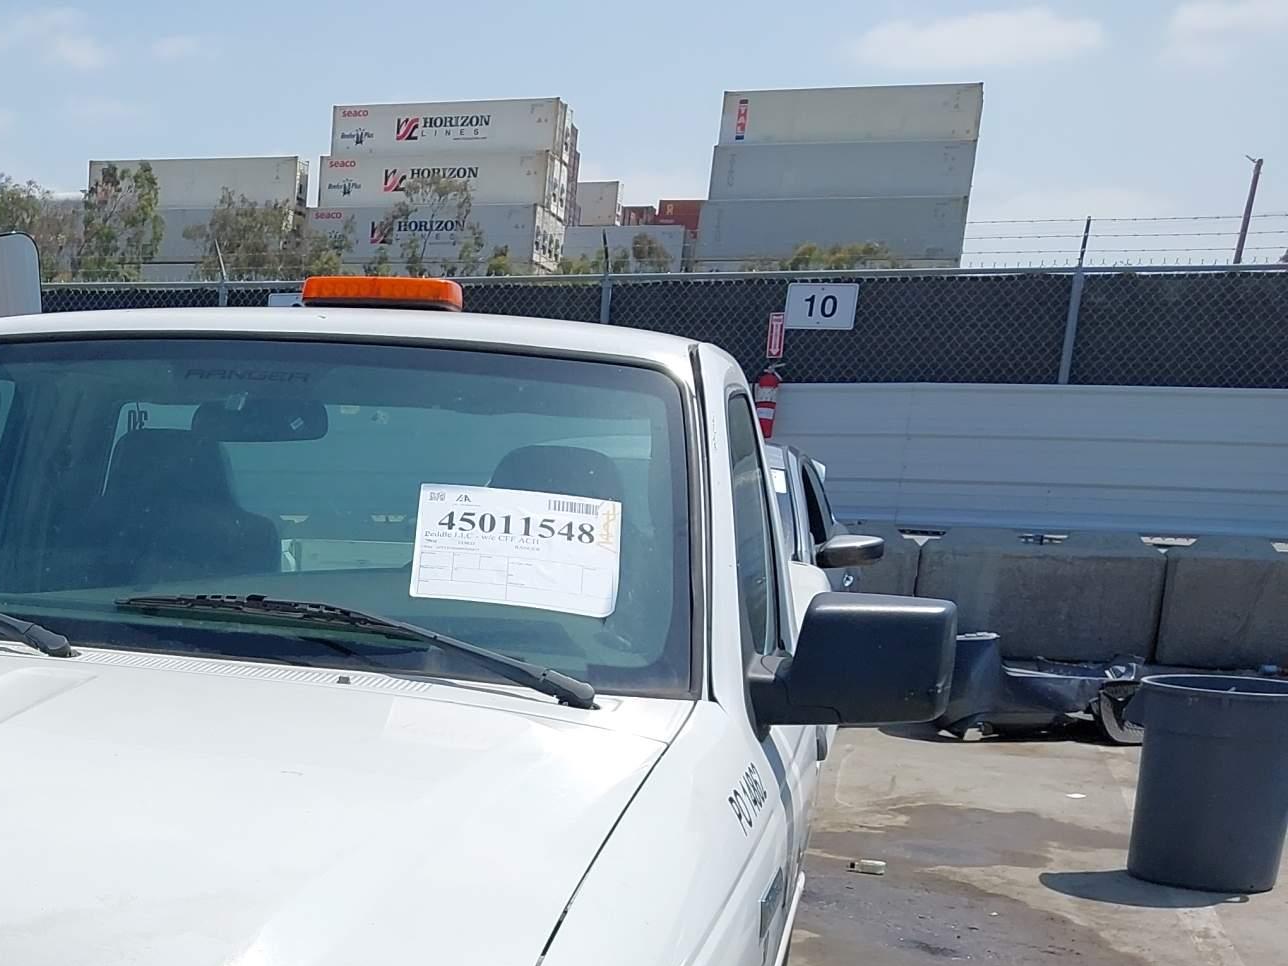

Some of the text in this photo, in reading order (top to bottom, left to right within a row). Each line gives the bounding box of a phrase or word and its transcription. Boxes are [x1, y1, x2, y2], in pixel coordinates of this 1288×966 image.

[342, 109, 369, 118] seaco
[422, 115, 491, 128] HORIZON
[421, 128, 479, 137] LINES
[329, 160, 356, 168] seaco
[410, 167, 479, 179] HORIZON
[314, 211, 342, 219] seaco
[397, 220, 465, 232] HORIZON
[804, 294, 838, 318] 10
[184, 369, 310, 383] RANGER
[438, 511, 594, 545] 45011548
[728, 789, 753, 837] PO
